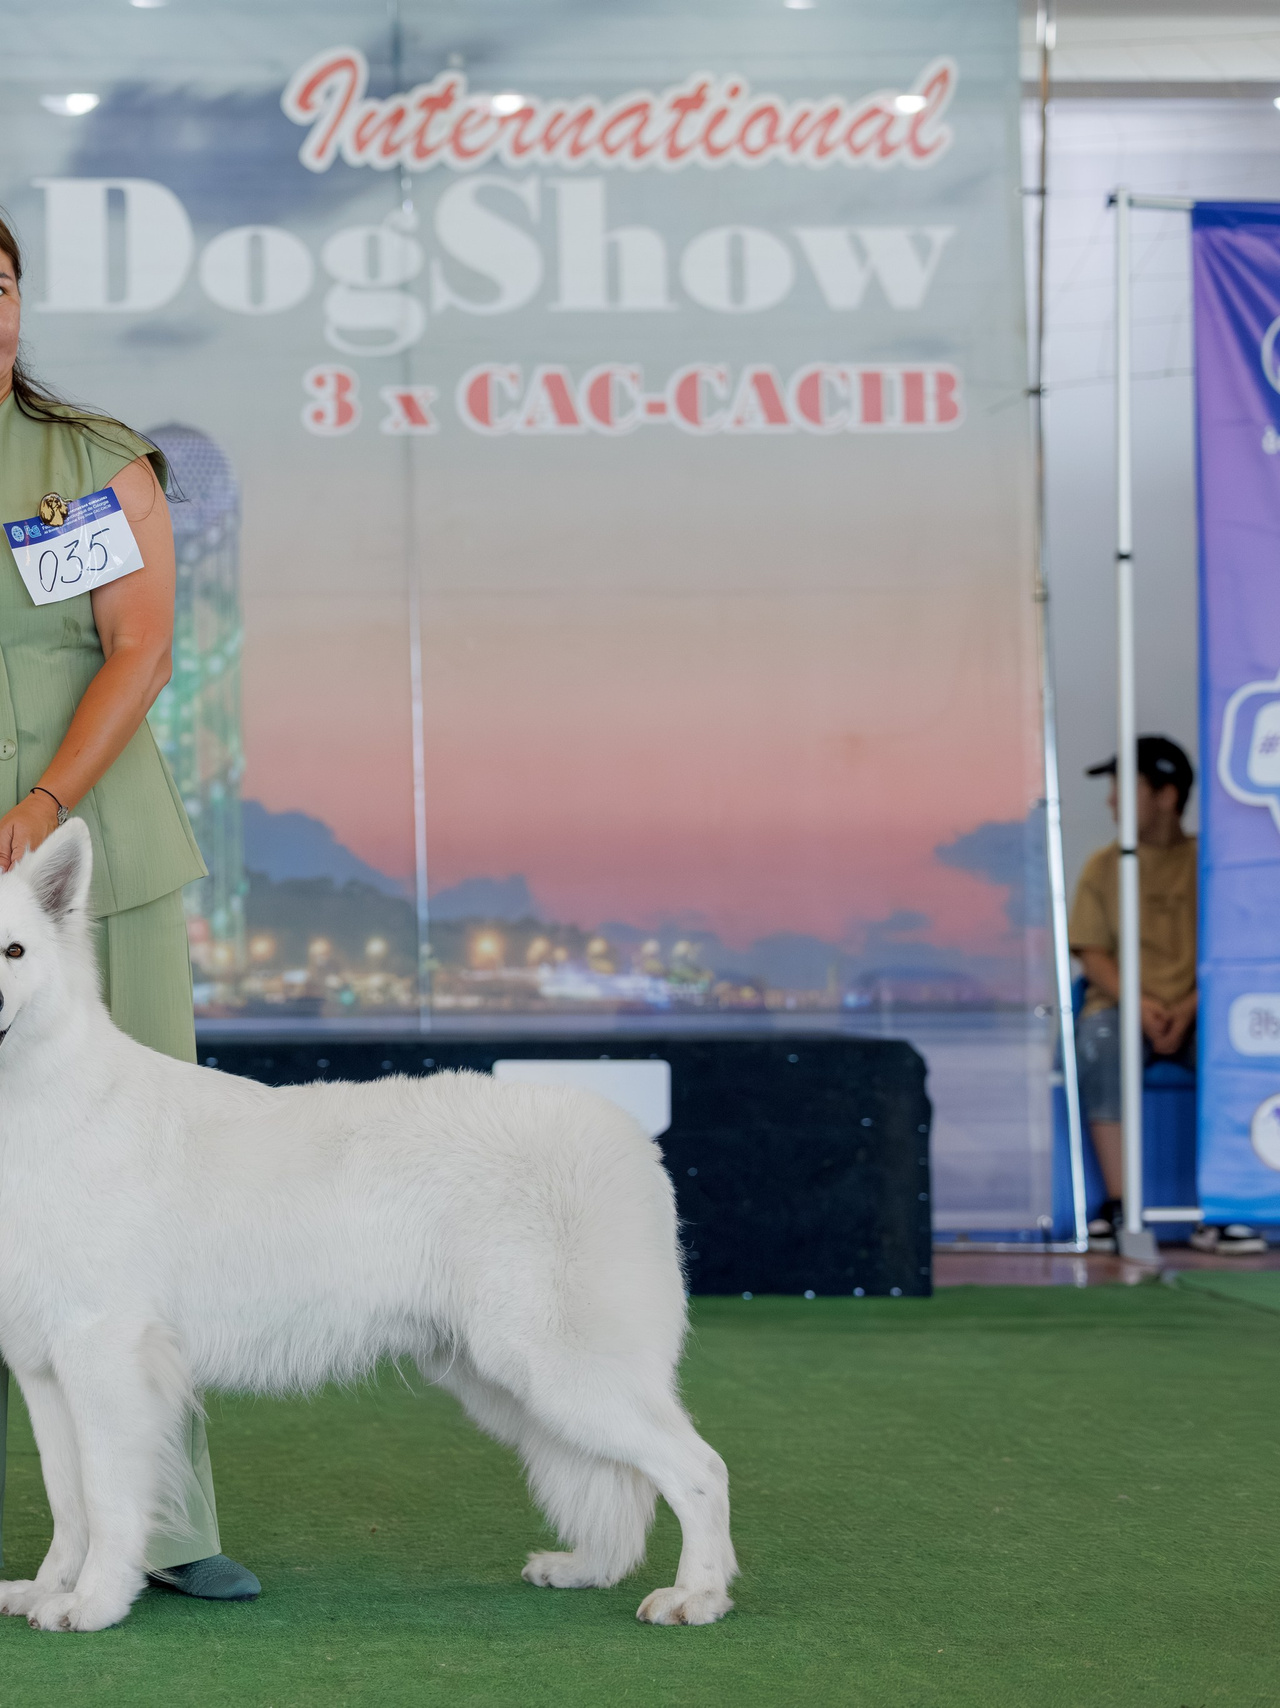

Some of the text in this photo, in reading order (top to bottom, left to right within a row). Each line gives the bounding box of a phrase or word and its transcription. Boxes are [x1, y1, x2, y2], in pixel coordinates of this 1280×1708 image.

[286, 48, 957, 168] International
[31, 175, 957, 356] DogShow
[301, 363, 962, 436] 3 x CAC-CACIB
[39, 527, 110, 592] 035
